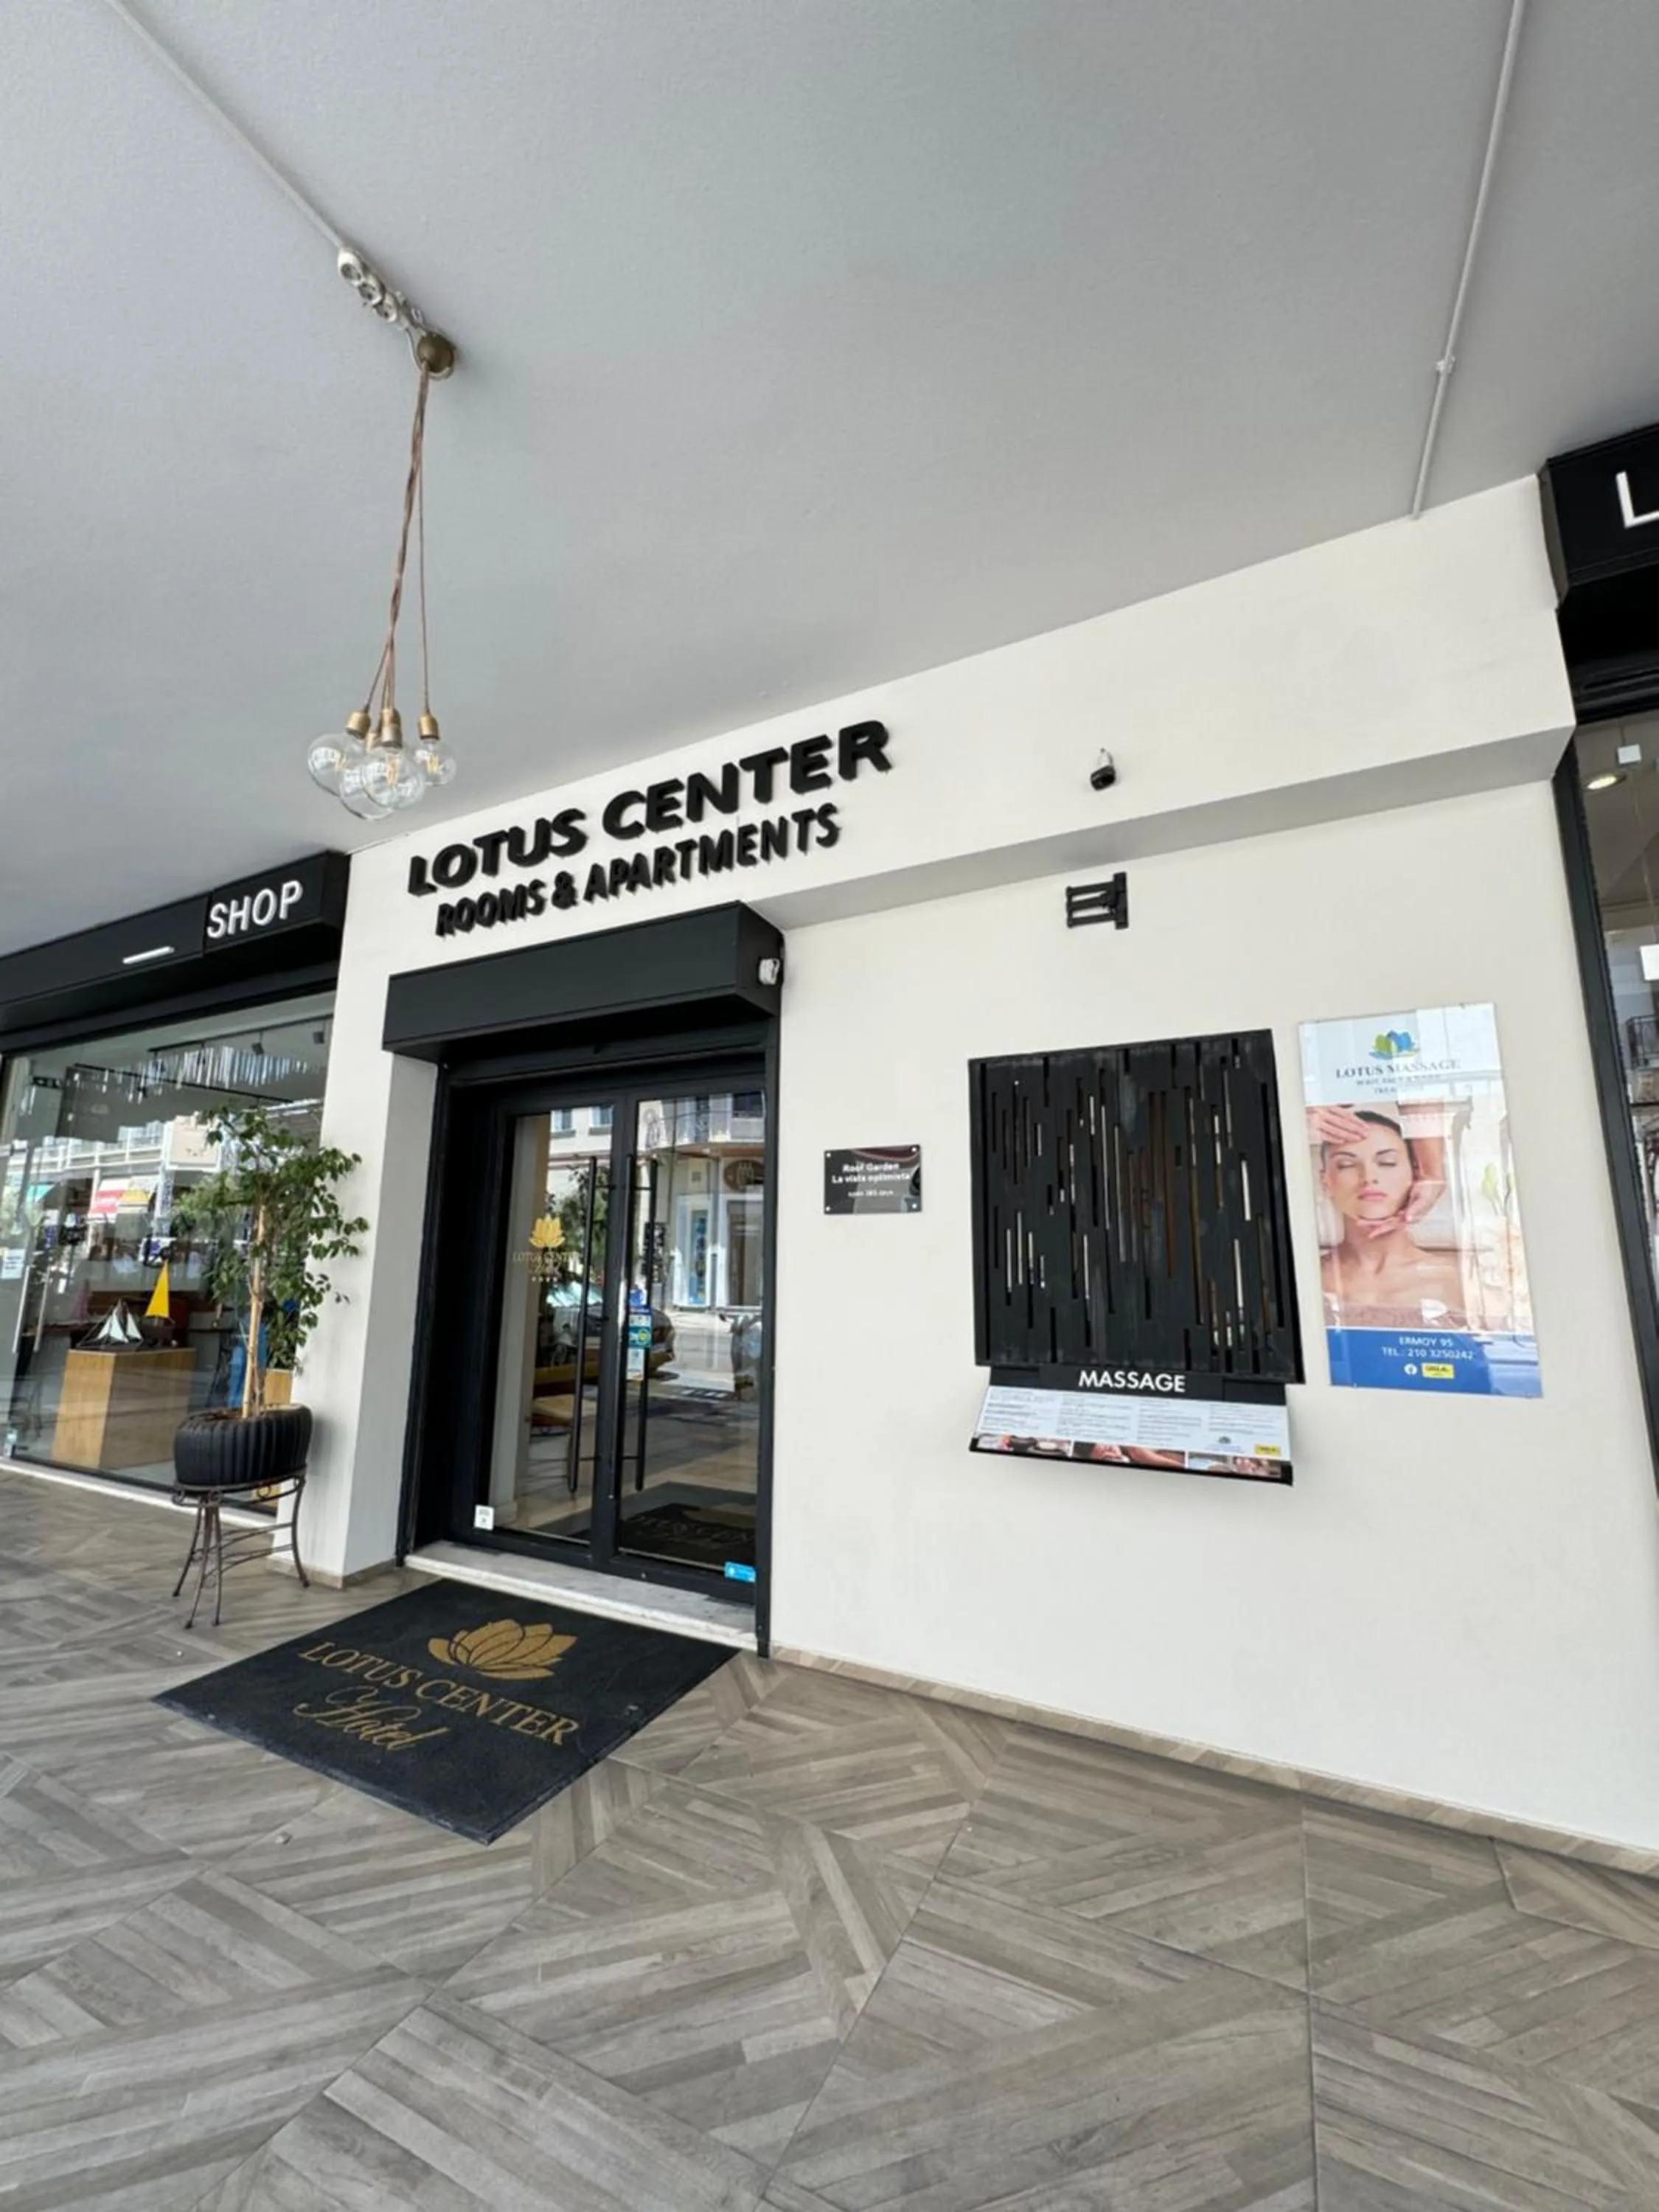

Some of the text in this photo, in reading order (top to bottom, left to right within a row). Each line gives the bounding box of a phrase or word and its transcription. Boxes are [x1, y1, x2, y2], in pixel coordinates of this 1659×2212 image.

[407, 720, 894, 897] LOTUS CENTER
[436, 802, 841, 939] ROOMS & APARTMENTS
[206, 880, 303, 939] SHOP
[1336, 1065, 1383, 1079] LOTUS
[866, 1162, 900, 1172] Garden
[1078, 1370, 1186, 1392] MASSAGE
[293, 1685, 450, 1752] Hotel
[299, 1641, 580, 1745] LOTUS CENTER
